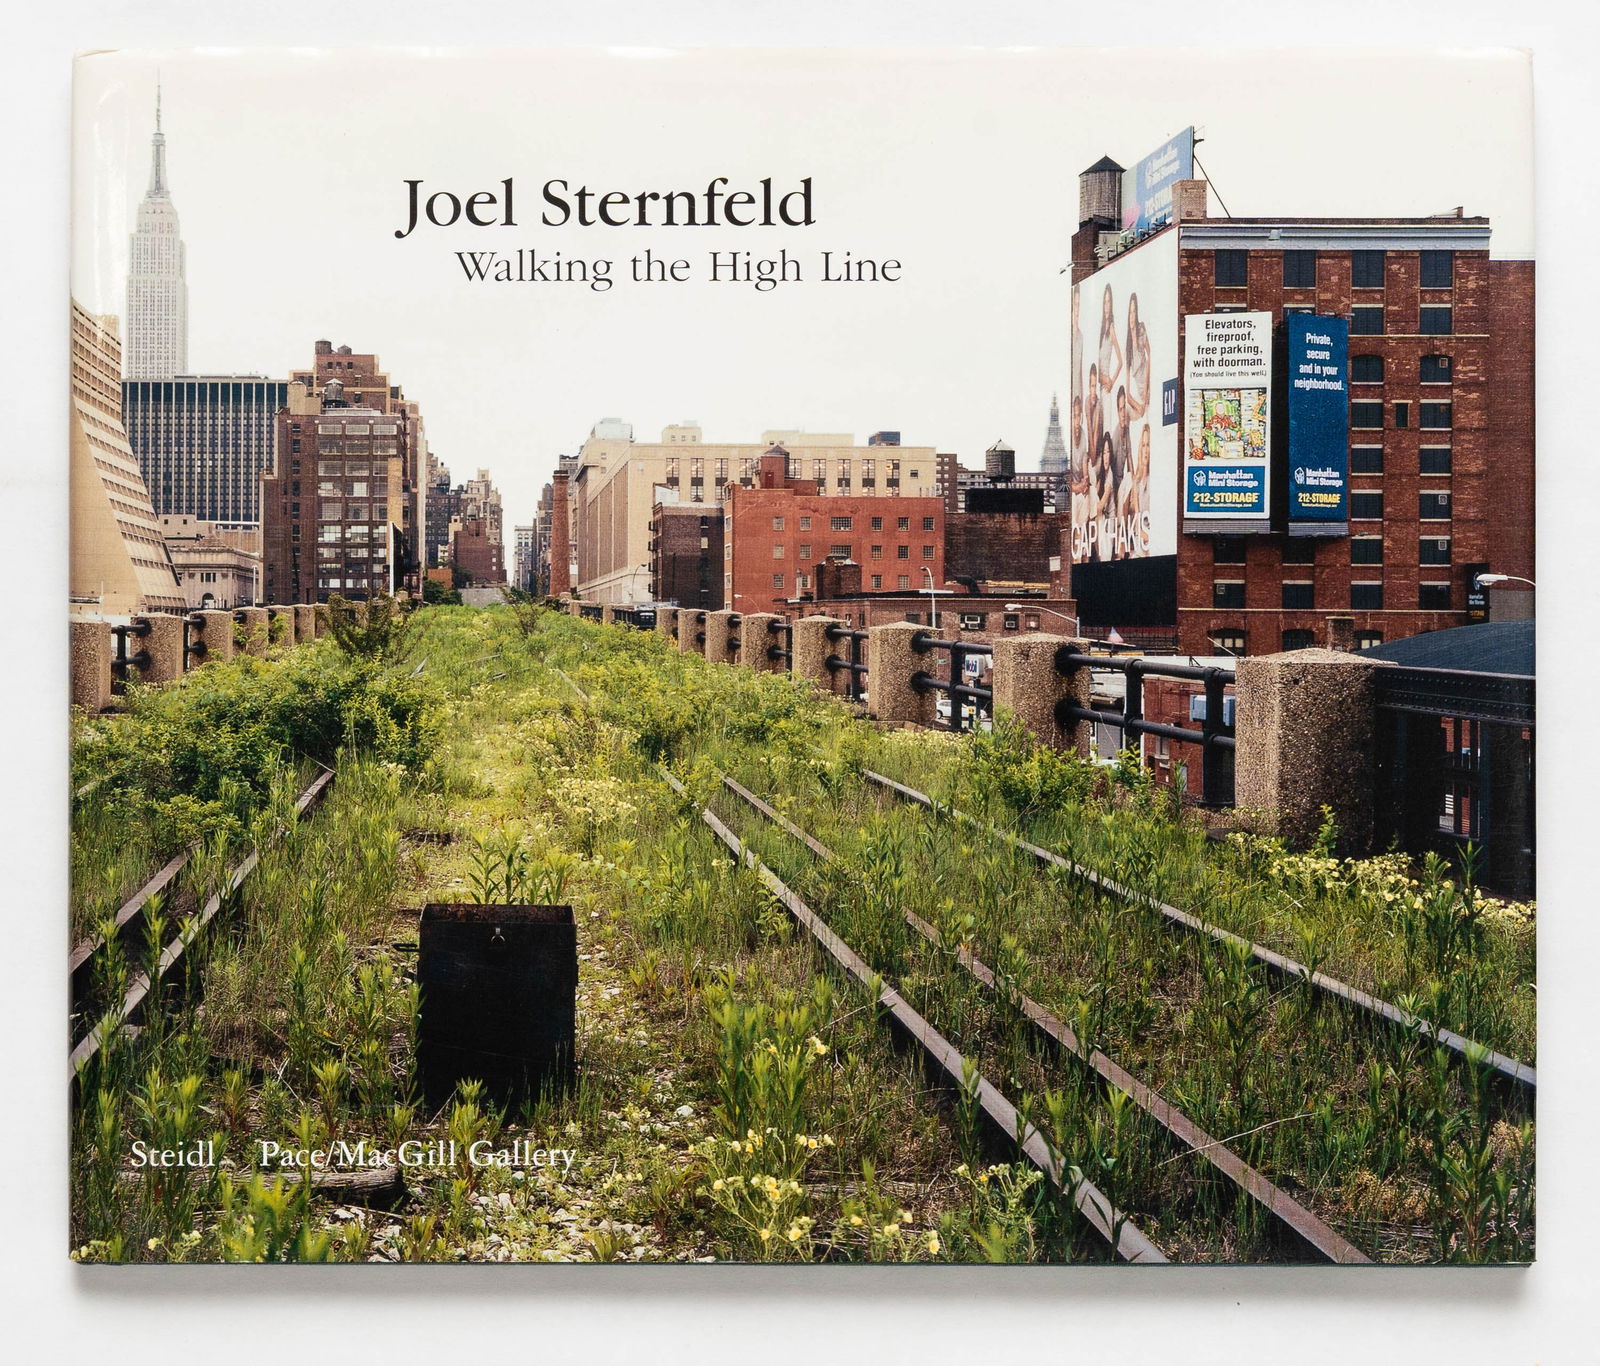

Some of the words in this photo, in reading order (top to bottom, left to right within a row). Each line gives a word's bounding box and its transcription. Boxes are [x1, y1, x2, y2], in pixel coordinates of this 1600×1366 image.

[394, 178, 518, 239] Joel
[541, 177, 817, 228] Sternfeld
[454, 248, 614, 292] Walking
[630, 249, 691, 282] the
[708, 249, 803, 292] High
[820, 251, 902, 282] Line
[1205, 319, 1257, 330] Elevators,
[1305, 332, 1334, 347] Private,
[1197, 345, 1217, 355] free
[1306, 349, 1330, 360] secure
[1193, 357, 1215, 368] with
[1218, 357, 1266, 368] doorman.
[1299, 363, 1313, 374] and
[1314, 363, 1322, 374] in
[1322, 365, 1338, 377] your
[1294, 378, 1345, 391] neighborhood.
[1208, 469, 1254, 479] Manhattan
[1305, 467, 1340, 478] Manhattan
[1208, 479, 1226, 487] Mini
[1226, 479, 1259, 488] Storage
[1320, 477, 1343, 487] Storage
[1193, 492, 1259, 503] 212-STORAGE
[1298, 492, 1341, 504] 212-STORAGE
[1071, 521, 1098, 559] GAP
[130, 1141, 214, 1168] Steidl
[260, 1140, 457, 1168] Pace/MacGill
[469, 1140, 577, 1174] Gallery
